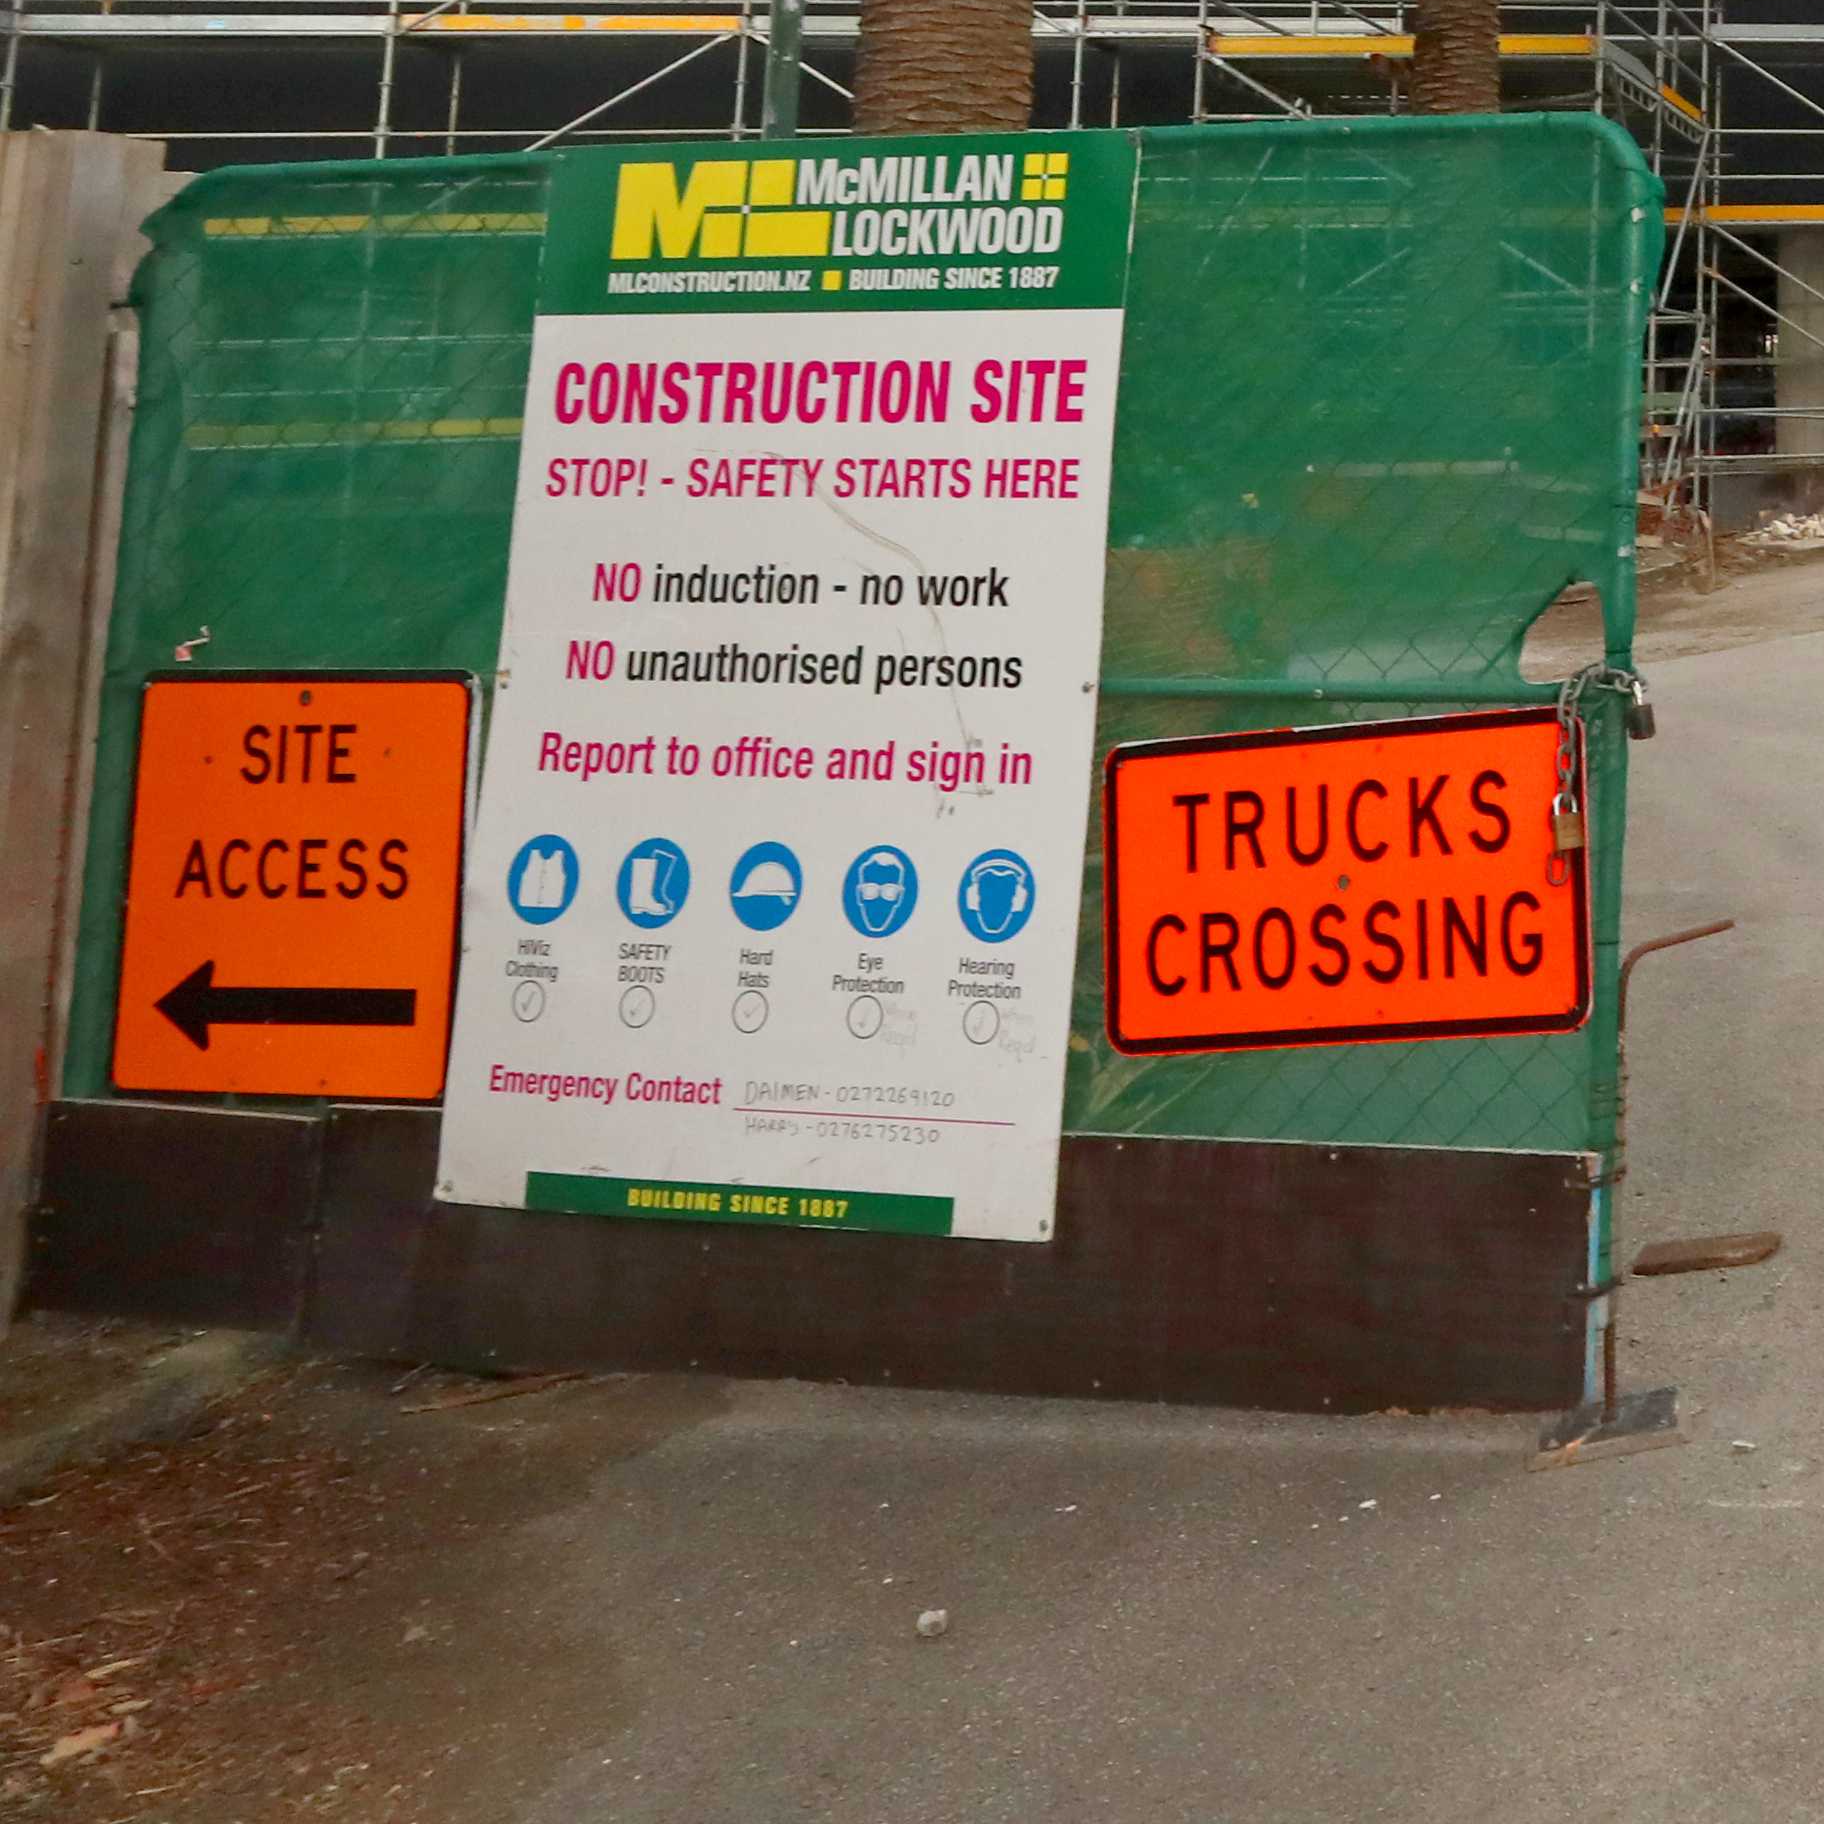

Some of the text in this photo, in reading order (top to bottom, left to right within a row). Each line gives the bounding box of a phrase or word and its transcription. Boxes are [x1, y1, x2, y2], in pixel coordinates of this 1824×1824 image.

[796, 154, 1014, 205] McMILLAN
[832, 206, 1064, 257] LOCKWOOD
[607, 270, 812, 294] MLCONSTRUCTION.NZ
[849, 266, 1060, 290] BUILDING SINCE 1887
[554, 359, 1088, 424] CONSTRUCTION SITE
[546, 458, 648, 497] STOP!
[686, 458, 824, 498] SAFETY
[833, 458, 972, 498] STARTS
[984, 459, 1081, 499] HERE
[592, 563, 642, 603] NO
[653, 564, 820, 604] induction
[860, 573, 903, 606] no
[917, 567, 1010, 607] work
[565, 640, 1023, 694] NO unauthorised persons
[240, 724, 358, 784] SITE
[537, 732, 1033, 792] Report to office and sign in
[1172, 769, 1511, 874] TRUCKS
[174, 838, 410, 900] ACCESS
[618, 943, 672, 961] SAFETY
[739, 948, 774, 966] Hard
[1146, 891, 1544, 997] CROSSING
[505, 960, 559, 983] Clothing
[618, 965, 665, 983] BOOTS
[858, 953, 884, 973] Eye
[959, 957, 1015, 979] Hearing
[737, 971, 770, 988] Hats
[832, 975, 905, 994] Protection
[948, 980, 1021, 999] Protection
[490, 1064, 723, 1105] Emergency Contact
[836, 1086, 955, 1107] 0272269120
[627, 1188, 849, 1218] BUILDING SINCE 1887
